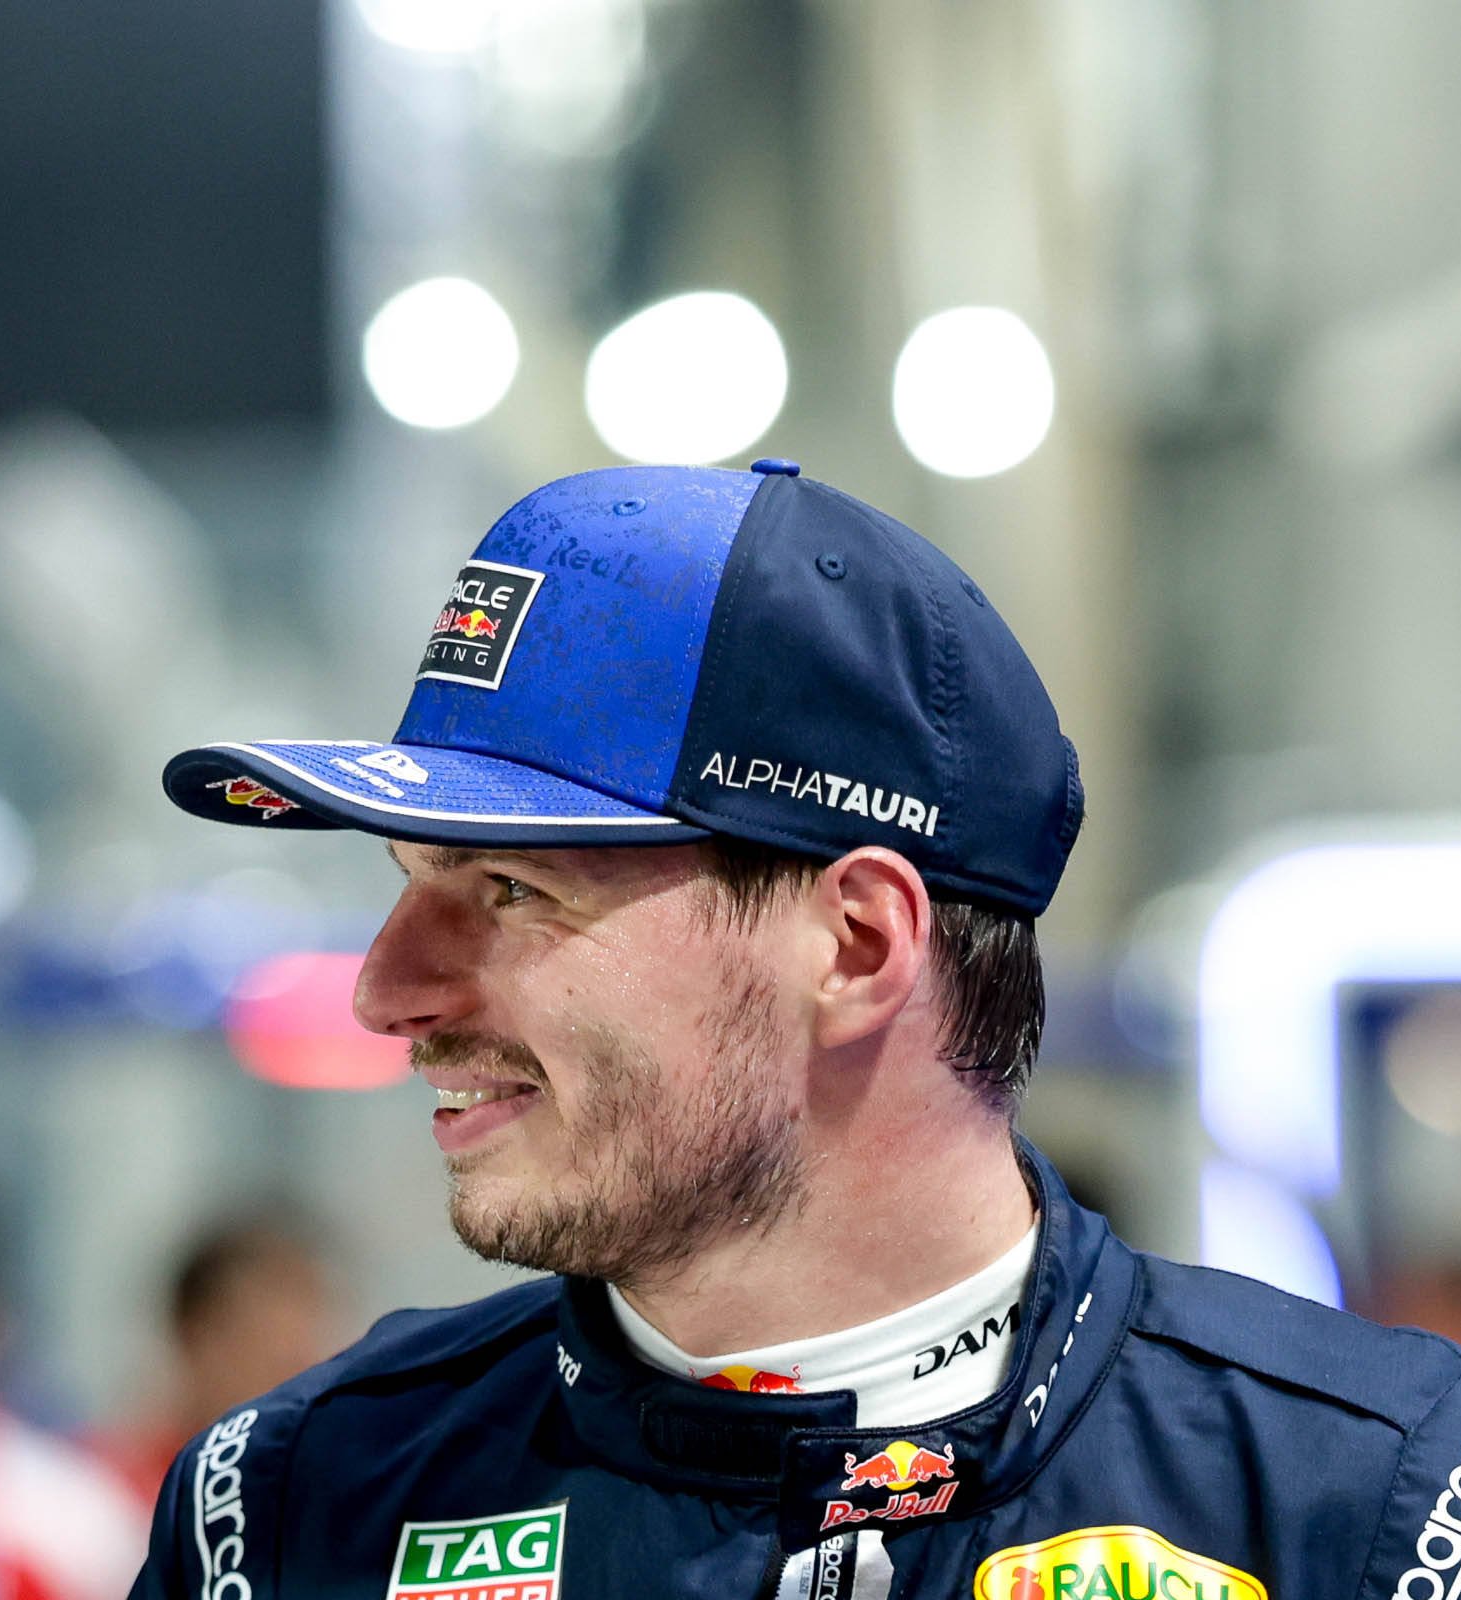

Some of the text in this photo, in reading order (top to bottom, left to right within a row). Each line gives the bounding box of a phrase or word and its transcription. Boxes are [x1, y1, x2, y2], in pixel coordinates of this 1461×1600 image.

[449, 579, 515, 610] ACLE
[699, 752, 940, 837] ALPHATAURI
[820, 1481, 960, 1531] Red Bull
[415, 1520, 553, 1579] TAG
